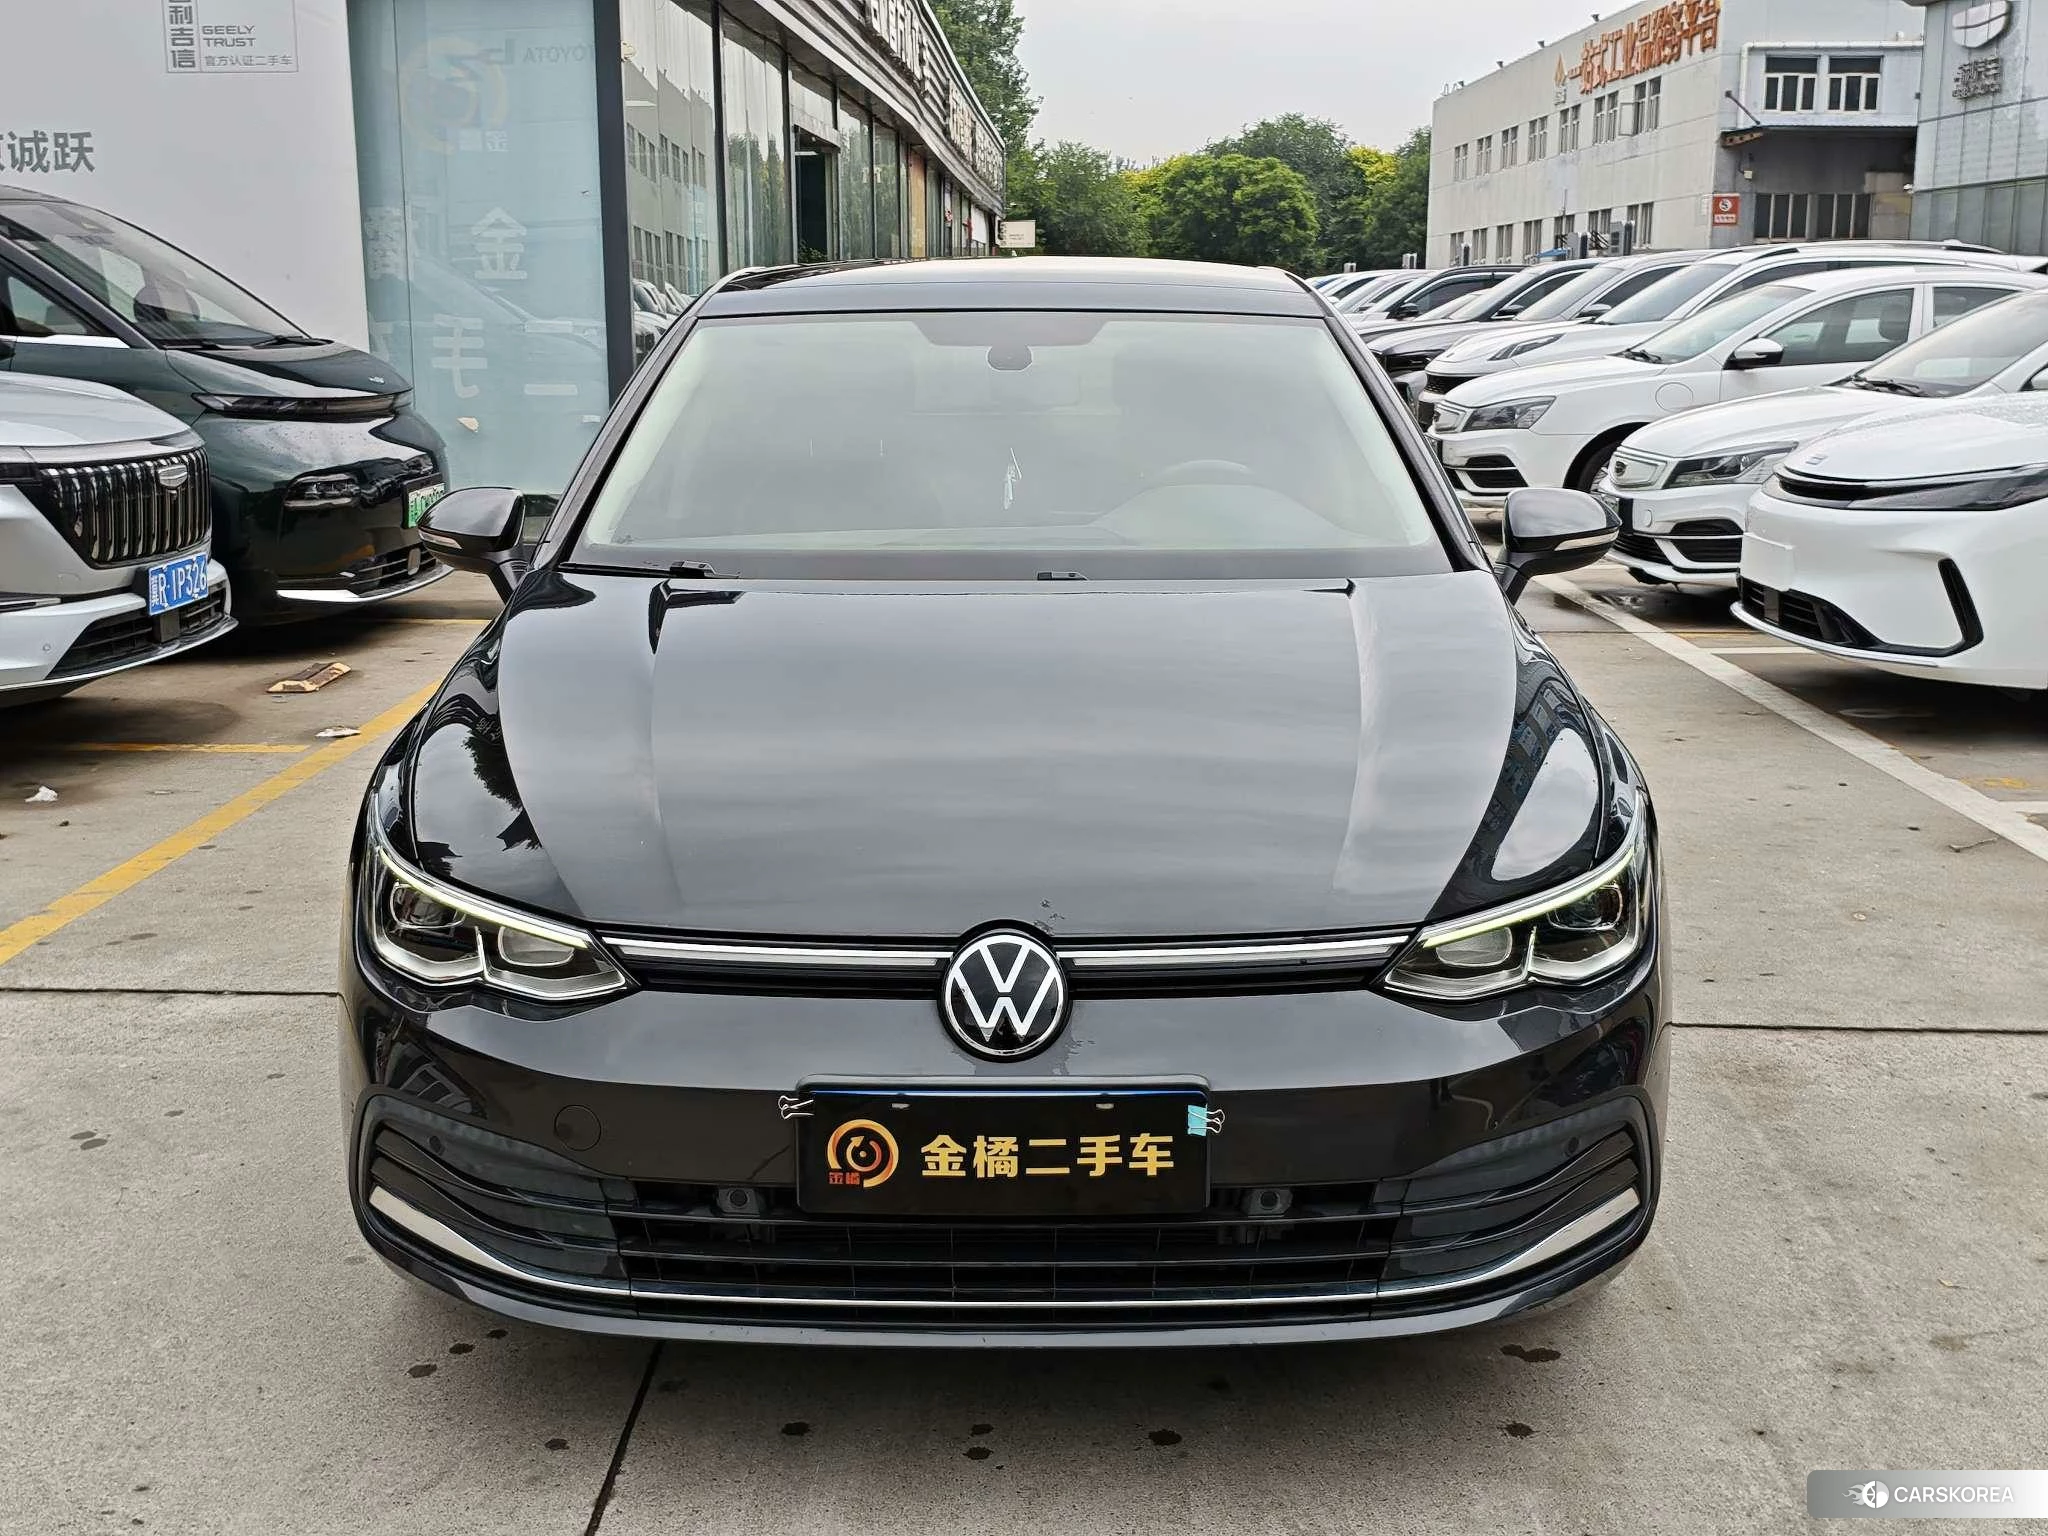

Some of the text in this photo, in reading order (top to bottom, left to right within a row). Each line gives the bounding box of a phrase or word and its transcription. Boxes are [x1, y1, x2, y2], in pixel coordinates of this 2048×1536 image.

[168, 0, 196, 68] 利吉信
[202, 25, 255, 35] GEELY
[202, 38, 256, 47] TRUST
[204, 55, 293, 67] 官方认证二手车
[0, 130, 96, 173] 诚跃
[921, 1133, 1175, 1178] 金橘二手车
